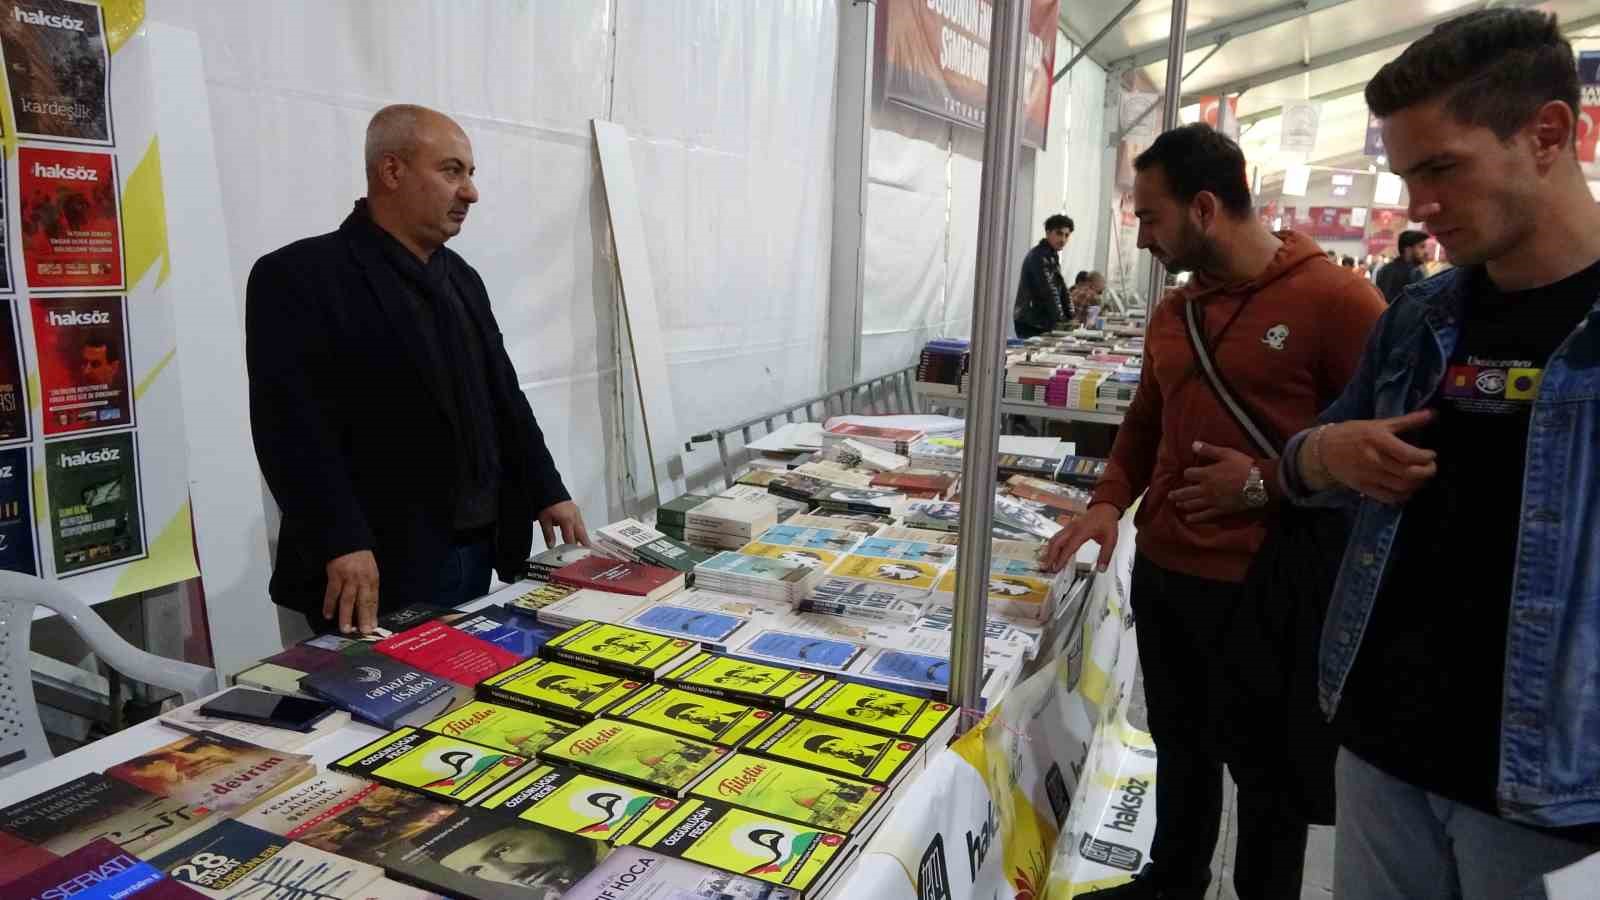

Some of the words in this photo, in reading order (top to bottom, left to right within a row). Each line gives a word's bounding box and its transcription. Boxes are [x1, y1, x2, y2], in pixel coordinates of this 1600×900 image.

[14, 6, 85, 32] haksöz
[33, 161, 98, 181] haksöz
[48, 310, 110, 326] haksöz
[60, 447, 121, 468] haksöz
[210, 756, 284, 796] devrim
[1103, 776, 1150, 833] haksöz
[171, 852, 229, 882] 28
[609, 857, 656, 892] HOCA
